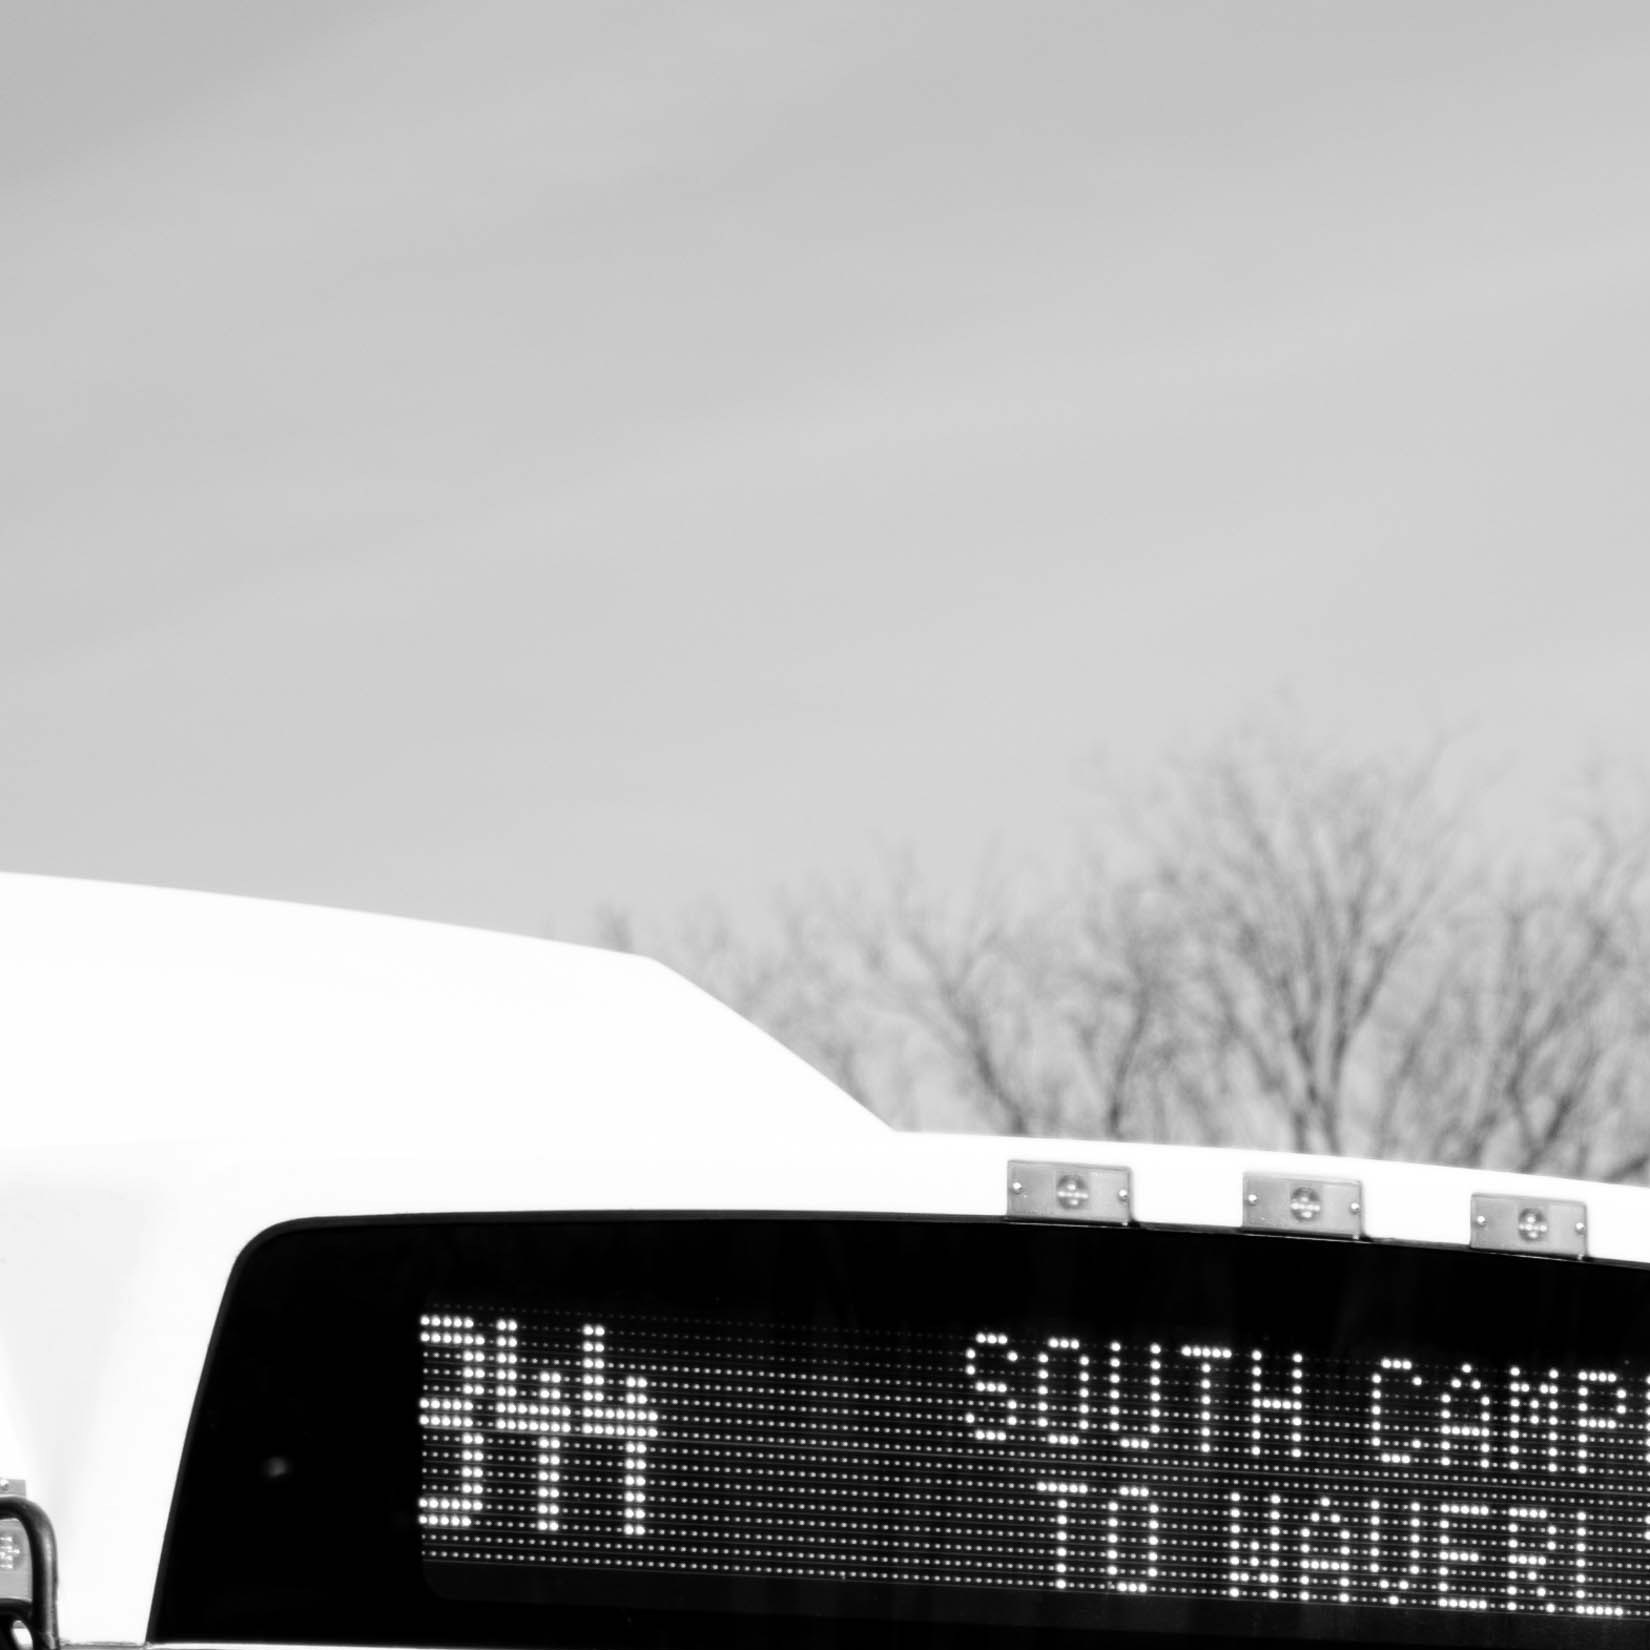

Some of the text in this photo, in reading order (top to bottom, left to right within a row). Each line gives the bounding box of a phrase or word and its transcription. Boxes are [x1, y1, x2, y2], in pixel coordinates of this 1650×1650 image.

[420, 1317, 659, 1536] 344
[966, 1335, 1303, 1459] SOUTH
[1038, 1483, 1160, 1594] TO
